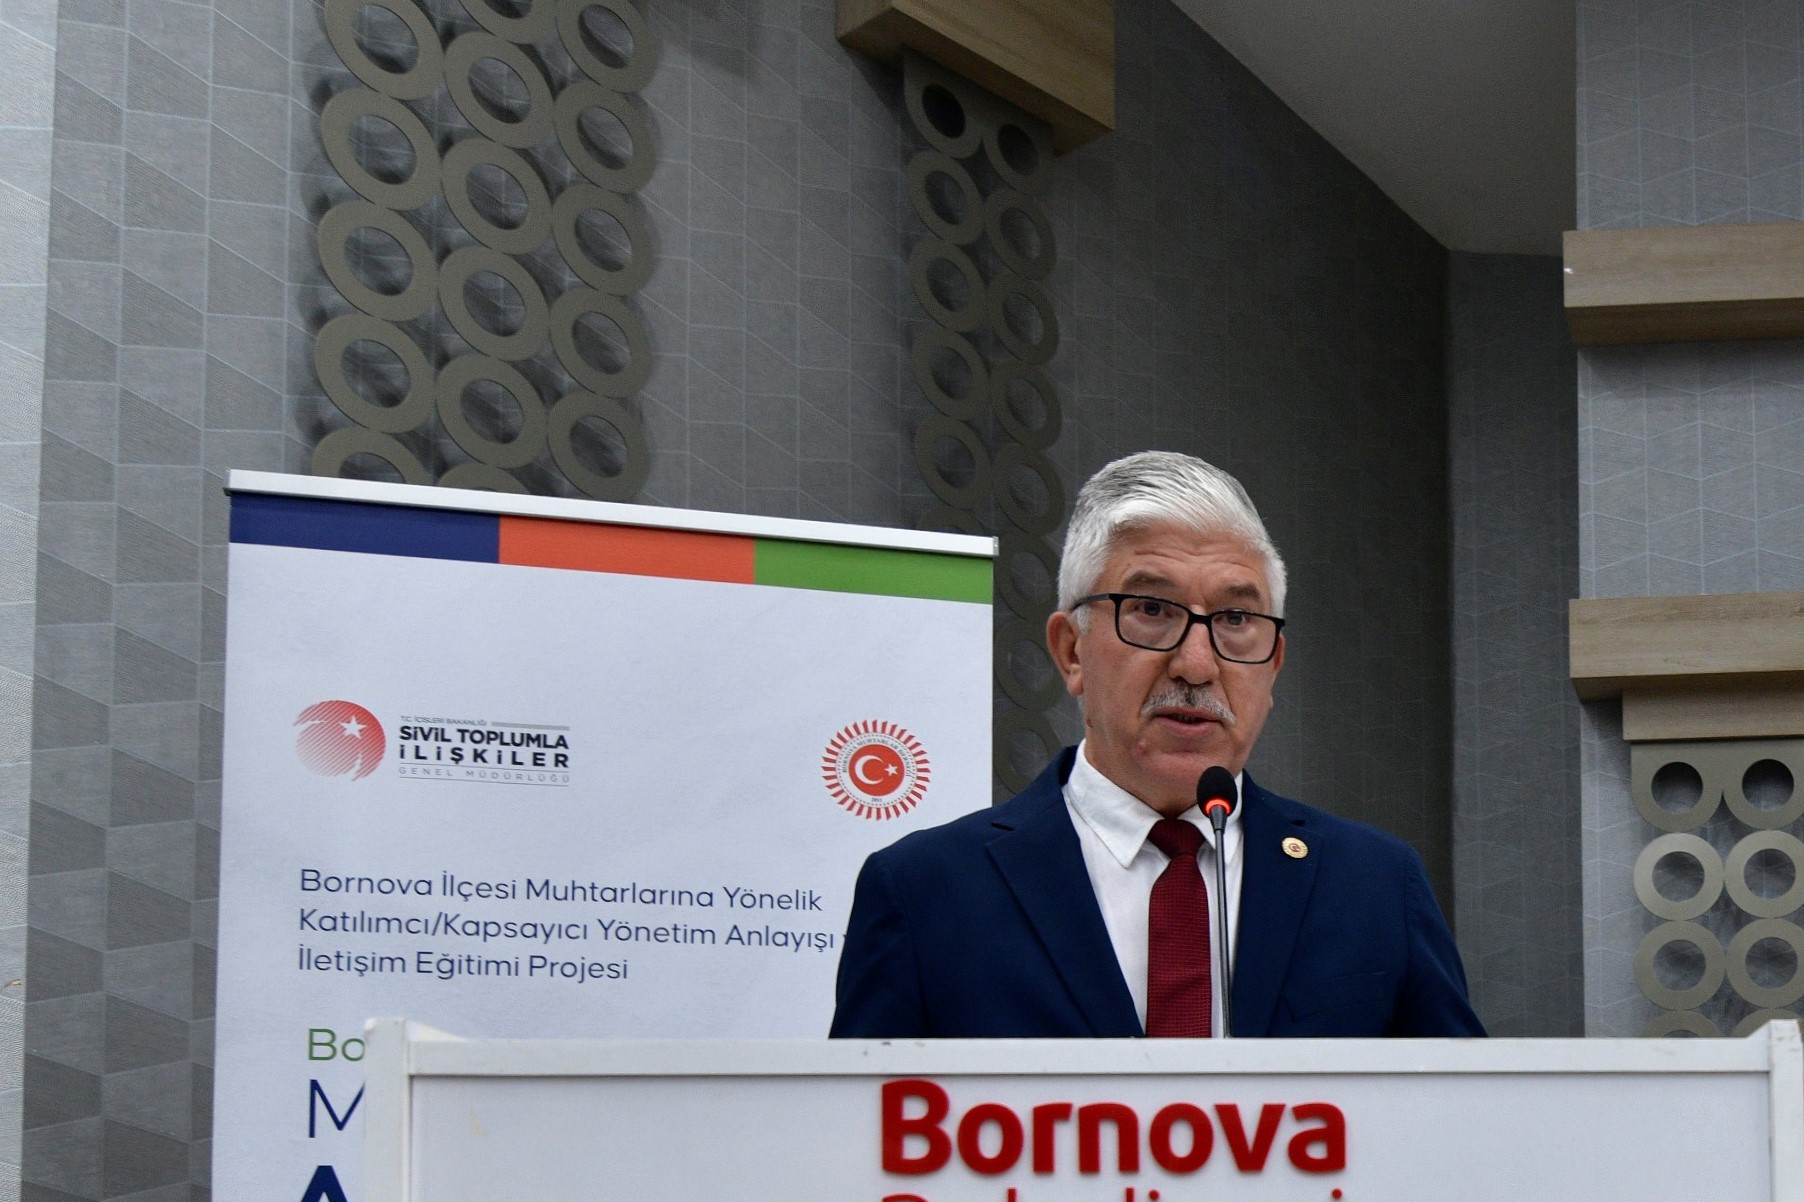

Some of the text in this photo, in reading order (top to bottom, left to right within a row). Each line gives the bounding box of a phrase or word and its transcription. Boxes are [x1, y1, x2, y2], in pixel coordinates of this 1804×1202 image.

[457, 728, 570, 750] TOPLUMLA
[399, 766, 453, 777] GENEL
[300, 868, 823, 912] Bornova İlçesi Muhtarlarına Yönelik
[299, 908, 588, 945] Katılımcı/Kapsayıcı
[597, 918, 716, 945] Yönetim
[724, 924, 835, 953] Anlayışı
[298, 943, 629, 984] İletişim Eğitimi Projesi
[881, 1077, 1347, 1175] Bornova
